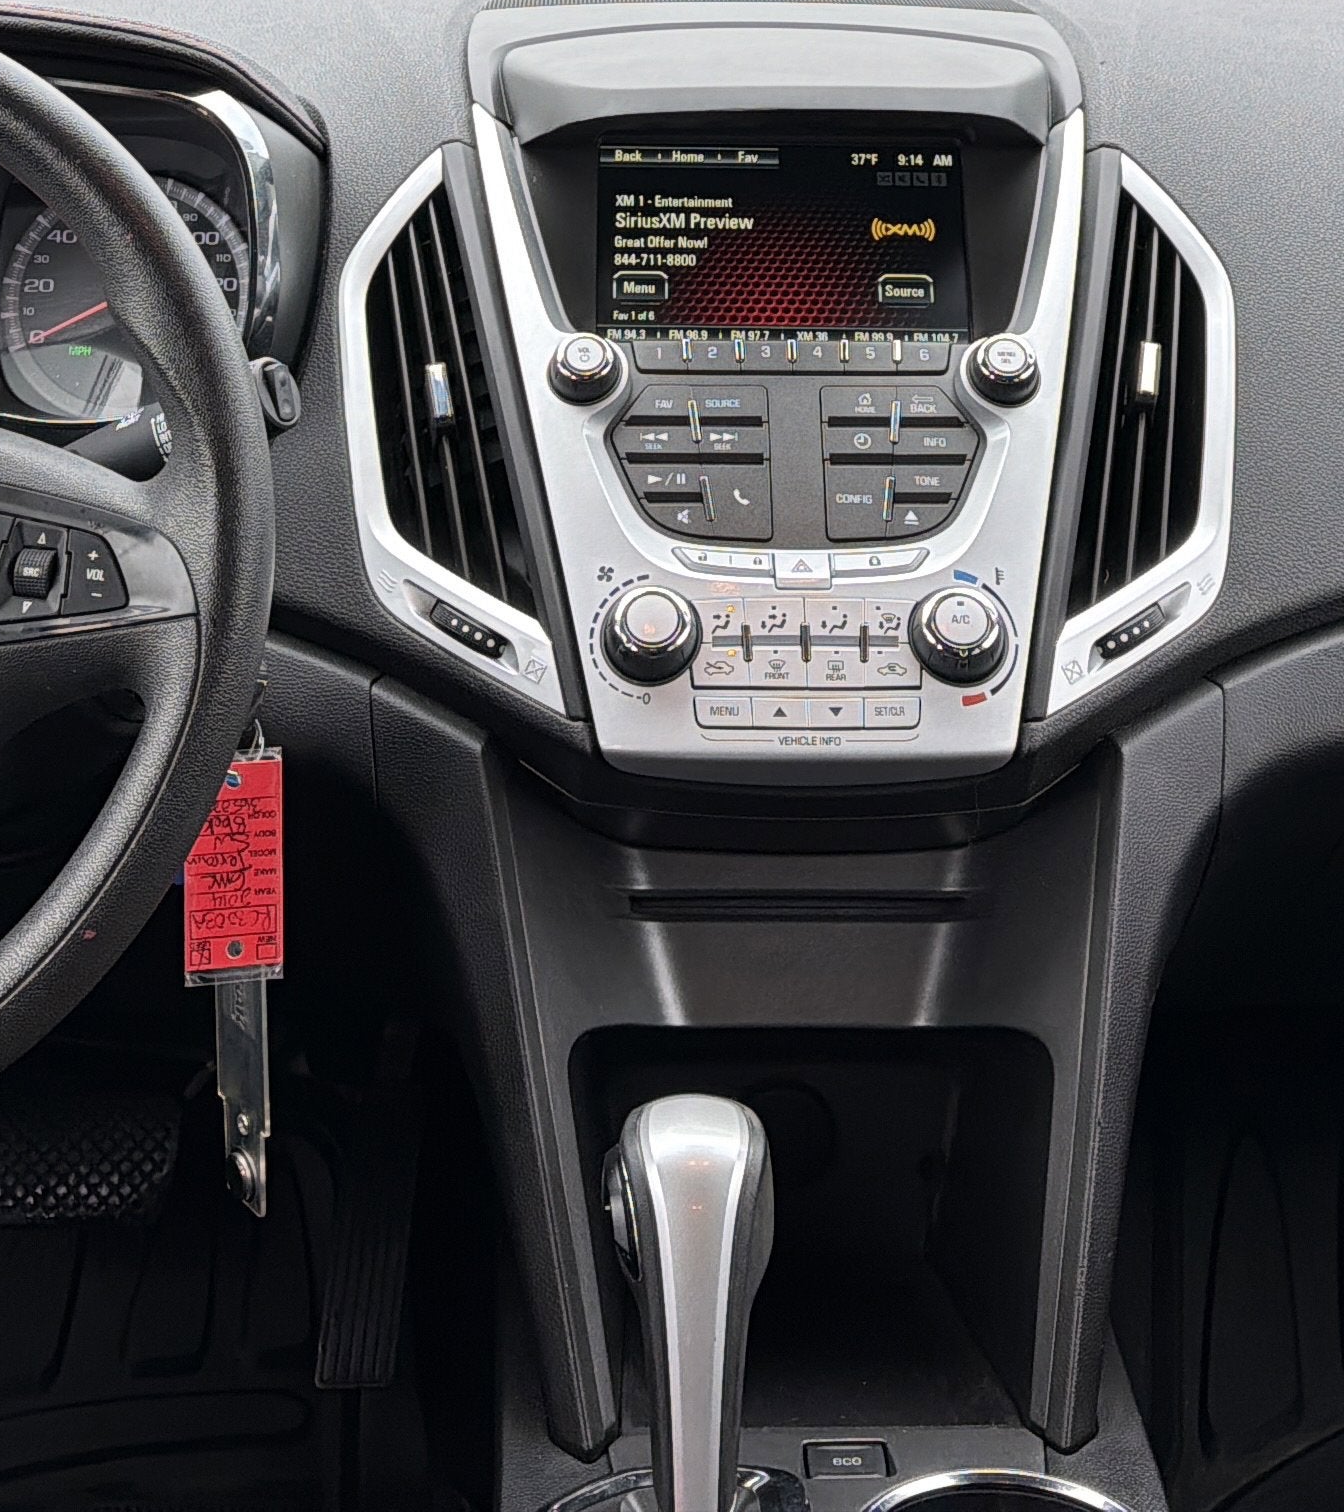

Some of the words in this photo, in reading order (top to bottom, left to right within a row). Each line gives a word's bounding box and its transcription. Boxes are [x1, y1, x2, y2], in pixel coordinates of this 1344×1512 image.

[614, 149, 643, 162] Back
[671, 150, 705, 163] Home
[738, 151, 759, 164] Fav
[850, 153, 879, 166] 37°F
[897, 153, 924, 167] 9:14
[932, 154, 953, 167] AM
[615, 194, 635, 207] XM
[638, 195, 644, 207] 1
[654, 195, 733, 208] Entertainment
[182, 212, 198, 222] 90
[615, 212, 686, 229] SiriusXM
[690, 213, 754, 230] Preview
[46, 229, 78, 244] 40
[614, 235, 645, 249] Great
[647, 236, 675, 249] Offer
[677, 236, 708, 249] Now!
[33, 254, 50, 264] 30
[215, 253, 232, 263] 110
[614, 253, 697, 266] 844-711-8800
[23, 278, 54, 293] 20
[623, 281, 656, 294] Menu
[884, 284, 925, 298] Source
[23, 307, 34, 316] 10
[612, 311, 629, 321] Fav
[631, 311, 636, 320] 1
[637, 311, 648, 321] of
[648, 311, 655, 321] 6
[29, 330, 45, 344] 0
[607, 329, 622, 340] FM
[623, 329, 646, 340] 94.3
[668, 329, 684, 340] FM
[685, 329, 708, 341] 96.9
[730, 330, 746, 341] FM
[747, 330, 770, 341] 97.7
[796, 331, 814, 341] XM
[854, 331, 870, 342] FM
[871, 331, 894, 342] 99.9
[913, 332, 929, 342] FM
[931, 333, 959, 343] 104.7
[68, 345, 92, 357] MPH
[655, 347, 663, 359] 1
[707, 347, 718, 358] 2
[760, 345, 771, 358] 3
[812, 346, 823, 358] 4
[865, 347, 875, 360] 5
[919, 349, 930, 361] 6
[655, 399, 673, 409] FAV
[705, 398, 741, 409] SOURCE
[909, 403, 937, 414] BACK
[854, 406, 877, 414] HOME
[645, 442, 663, 450] SEEK
[713, 442, 732, 450] SEEK
[923, 437, 947, 447] INFO
[914, 476, 940, 487] TONE
[835, 493, 873, 504] CONFIG
[22, 567, 41, 578] SRC
[86, 568, 105, 582] VOL
[951, 613, 971, 625] A/C
[763, 671, 790, 681] FRONT
[826, 673, 847, 682] REAR
[709, 705, 740, 718] MENU
[874, 705, 906, 718] SET/CLR
[778, 736, 817, 747] VEHICLE
[819, 736, 842, 747] INFO
[248, 810, 277, 820] COLOR
[253, 829, 277, 838] BODY
[248, 849, 277, 858] MODEL
[253, 868, 277, 877] MAKE
[254, 887, 277, 896] YEAR
[257, 935, 277, 943] NEW
[832, 1456, 863, 1467] ECO
